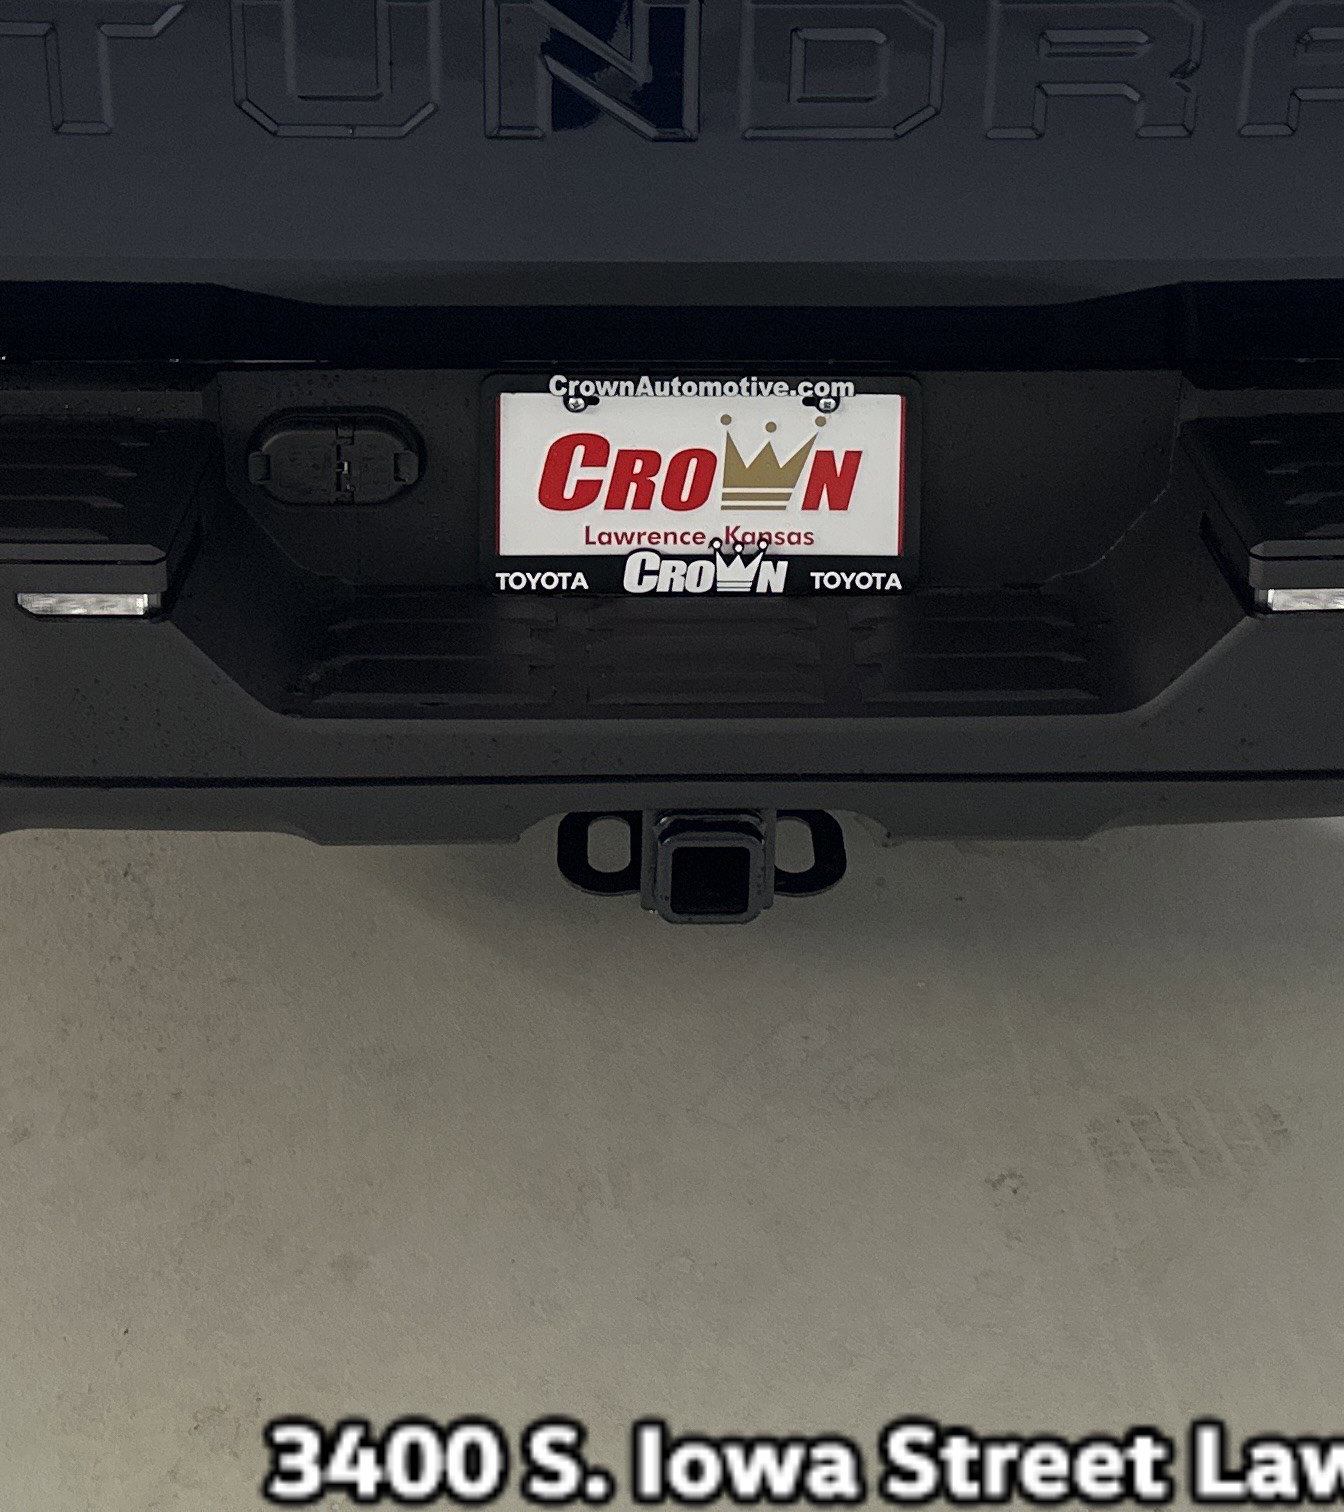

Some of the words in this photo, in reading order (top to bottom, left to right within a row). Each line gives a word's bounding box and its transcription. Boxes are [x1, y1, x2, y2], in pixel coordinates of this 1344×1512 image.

[548, 375, 856, 398] CrownAutomotive.com
[724, 525, 815, 546] Kansas
[495, 571, 590, 591] TOYOTA
[810, 571, 903, 591] TOYOTA
